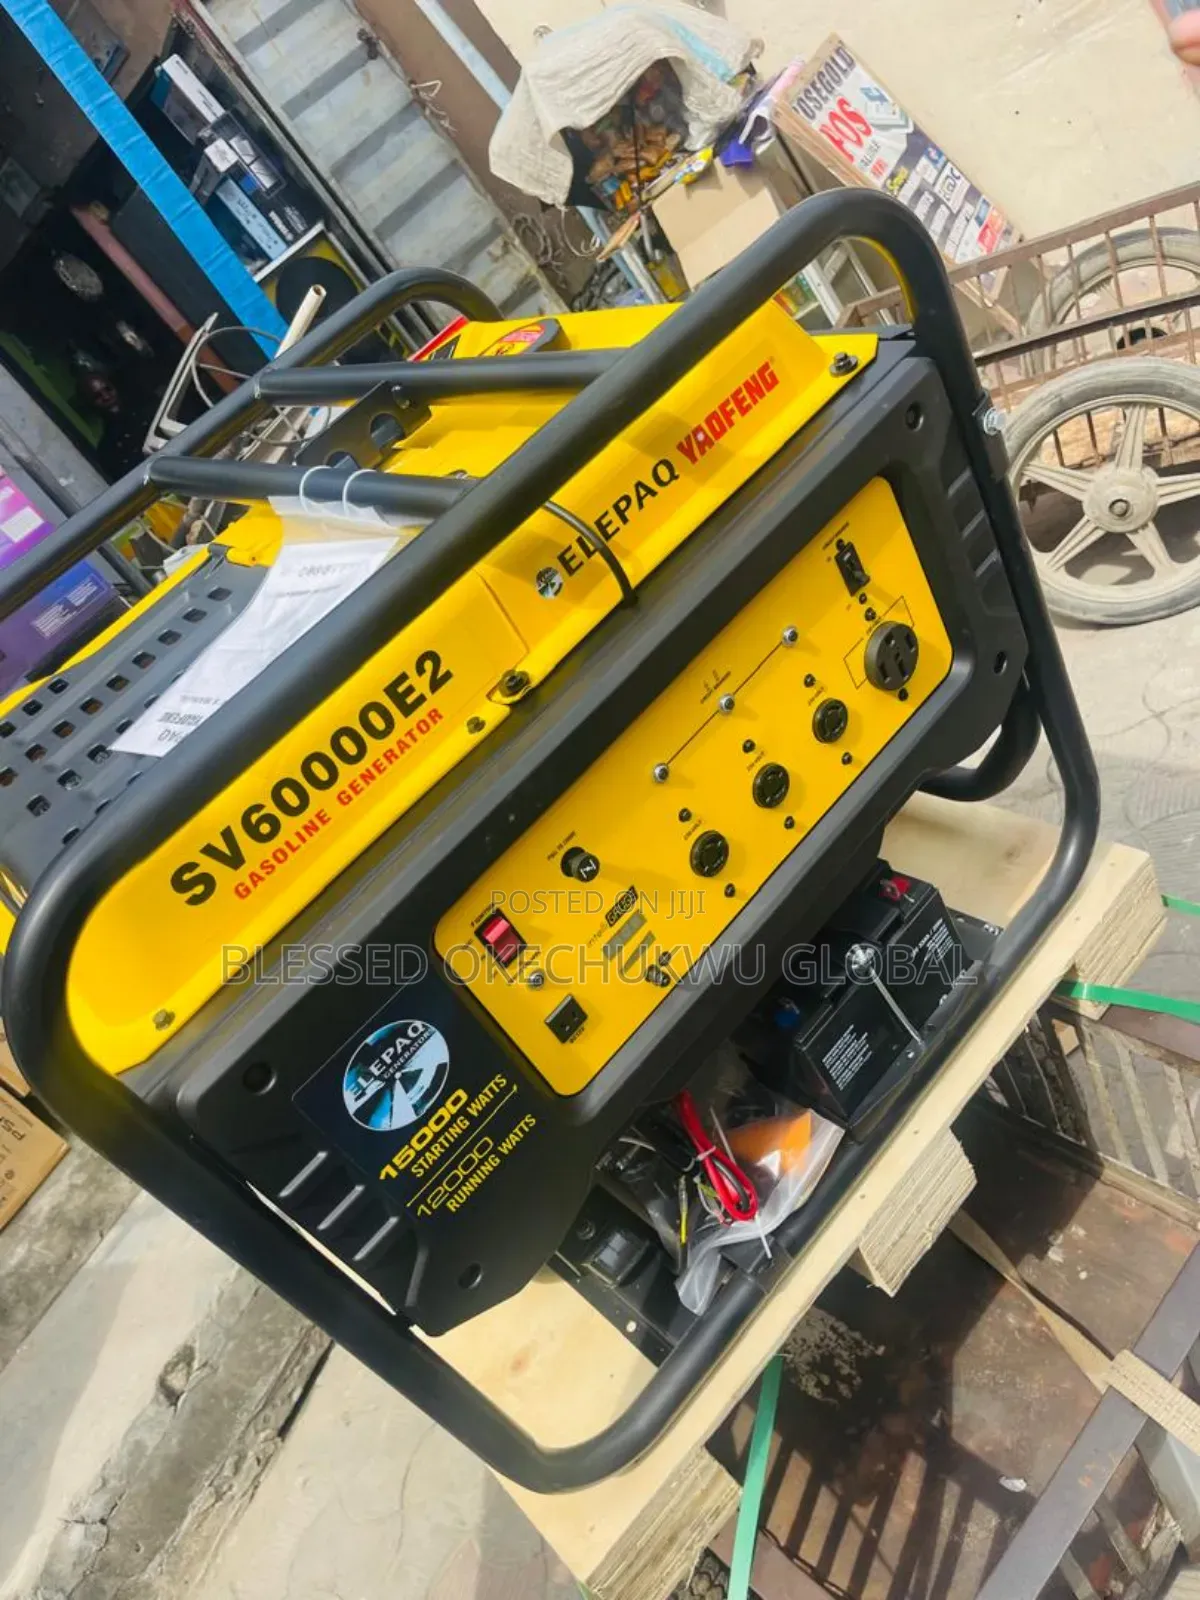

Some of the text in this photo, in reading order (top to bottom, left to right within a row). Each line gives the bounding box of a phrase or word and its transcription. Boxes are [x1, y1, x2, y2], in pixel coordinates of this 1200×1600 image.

[792, 46, 857, 122] OSEGOLD
[557, 360, 780, 577] ELEPAQ YAOFENG
[170, 650, 454, 906] SV60000E2
[234, 708, 445, 901] GASOLINE GENERATOR
[350, 1020, 427, 1097] ELEPAQ
[379, 1088, 469, 1180] 15000
[411, 1073, 508, 1178] STARTING WATTS
[446, 1113, 537, 1213] RUNNING WATTS
[416, 1136, 494, 1217] 12000
